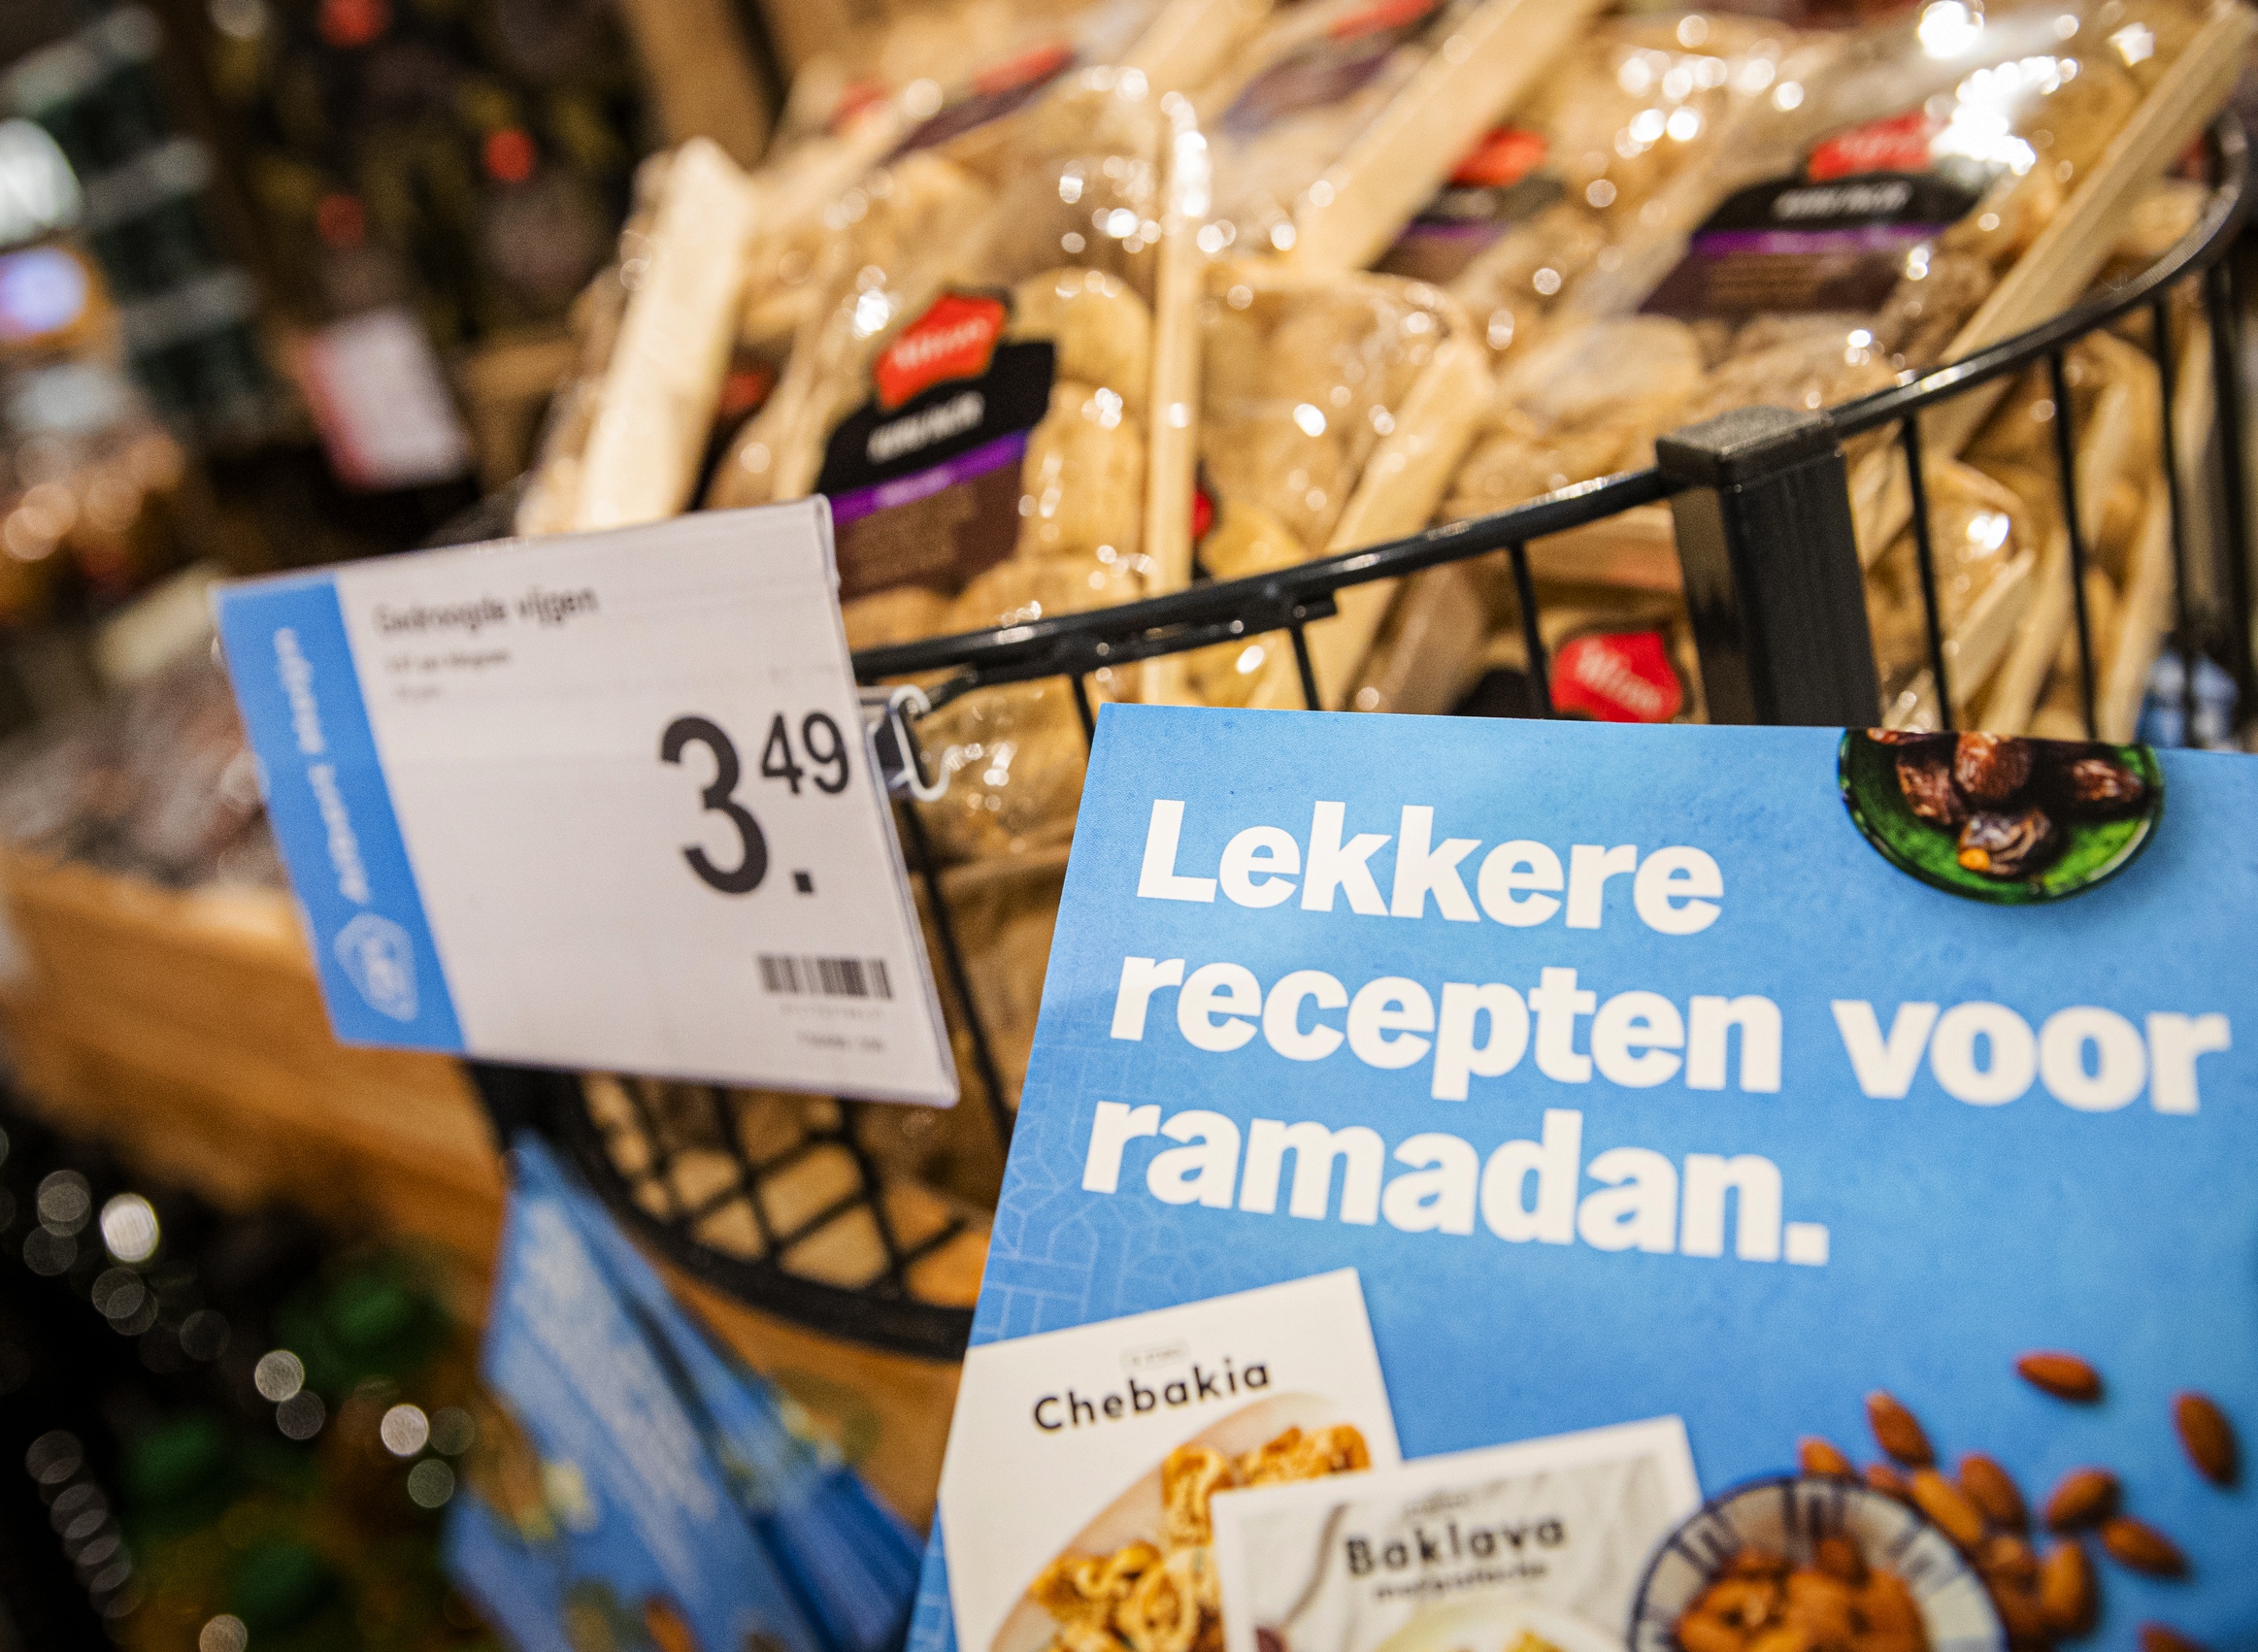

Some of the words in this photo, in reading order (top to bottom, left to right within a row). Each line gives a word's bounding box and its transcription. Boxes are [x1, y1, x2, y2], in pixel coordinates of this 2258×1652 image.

[1135, 798, 1724, 936] Lekkere
[1110, 955, 1783, 1101] recepten
[1832, 999, 2231, 1114] voor
[1081, 1100, 1830, 1267] ramadan.
[1031, 1357, 1272, 1434] Chebakia
[1344, 1514, 1567, 1577] Baklava
